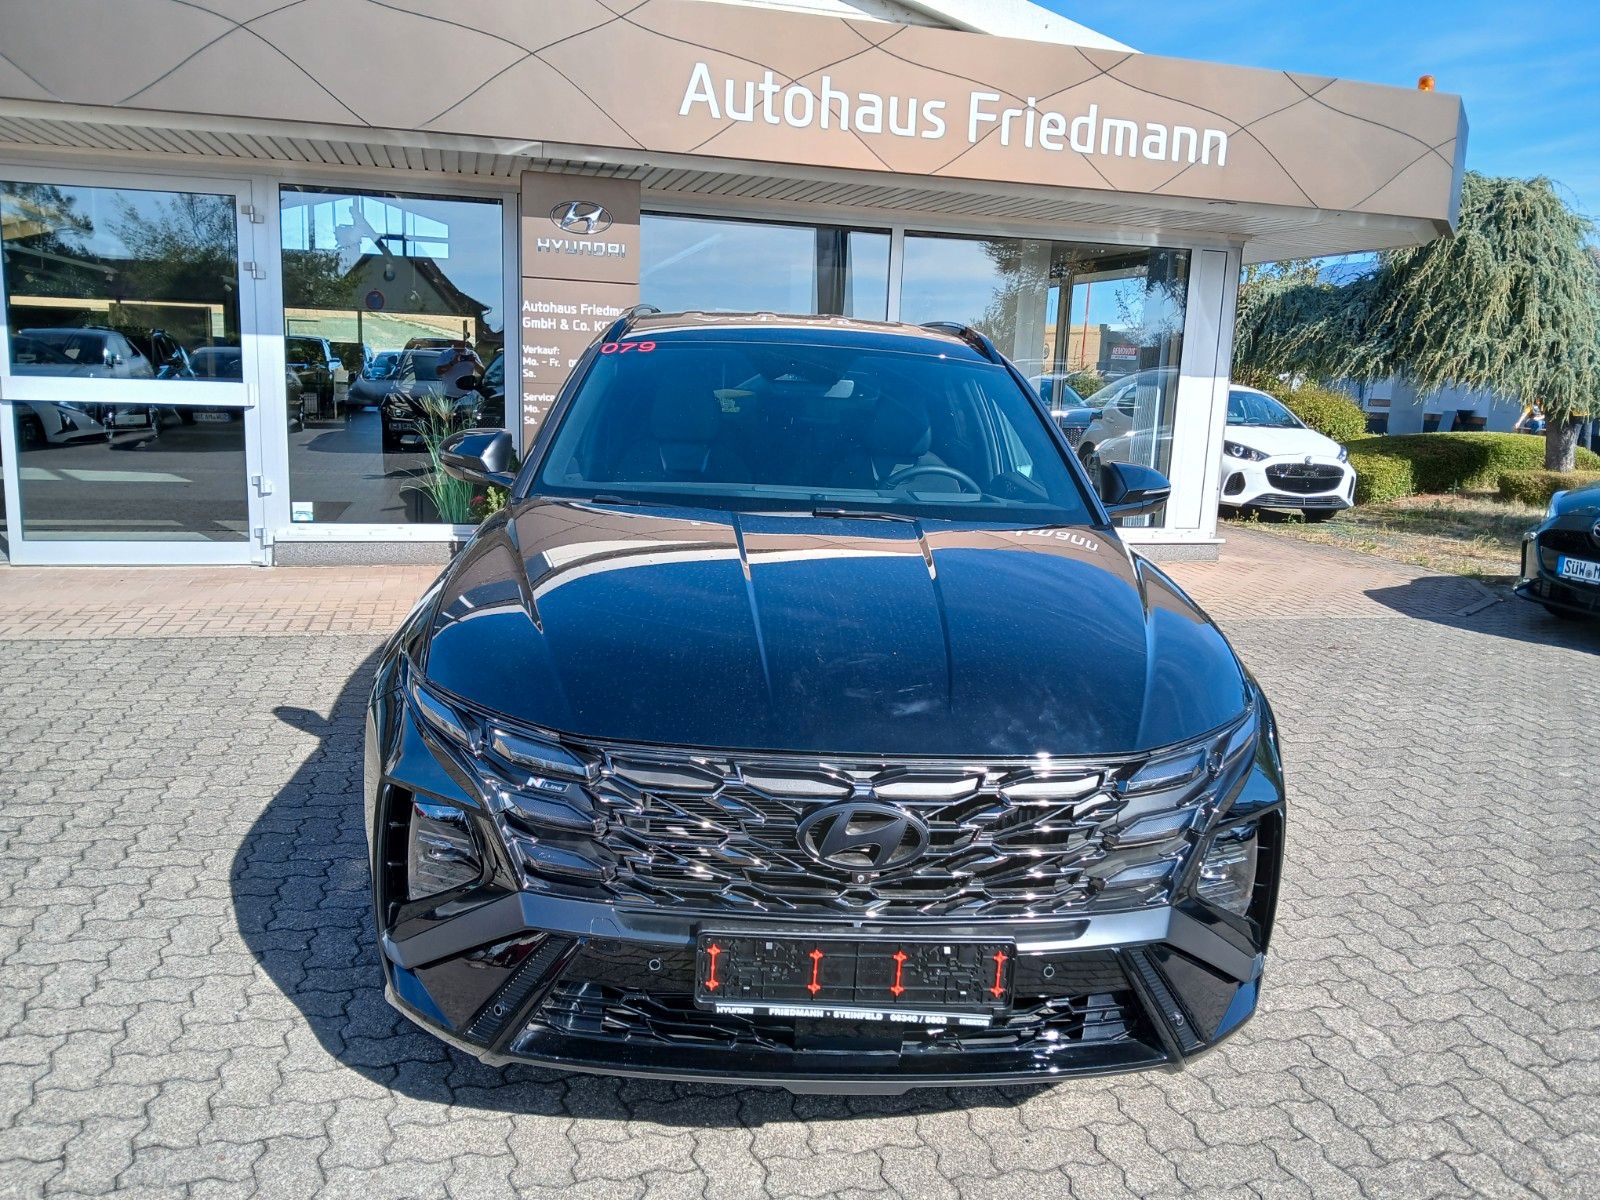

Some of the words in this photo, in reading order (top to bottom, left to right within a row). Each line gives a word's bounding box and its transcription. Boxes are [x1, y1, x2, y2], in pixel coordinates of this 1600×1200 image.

[678, 61, 947, 140] Autohaus
[967, 91, 1229, 167] Friedmann
[537, 238, 626, 257] HYUNDAI
[522, 300, 577, 315] Autohaus
[522, 316, 557, 330] GmbH
[559, 318, 570, 330] &
[572, 319, 591, 331] Co.
[522, 344, 560, 355] Verkauf:
[601, 341, 656, 354] 079
[522, 357, 540, 367] Mo.
[549, 358, 561, 367] Fr.
[522, 368, 537, 378] Sa.
[523, 404, 541, 414] Mo.
[523, 415, 538, 425] Sa.
[716, 1006, 754, 1015] HYUNDAI
[768, 1007, 824, 1018] FRIEDMANN
[833, 1010, 883, 1021] STEINFELD
